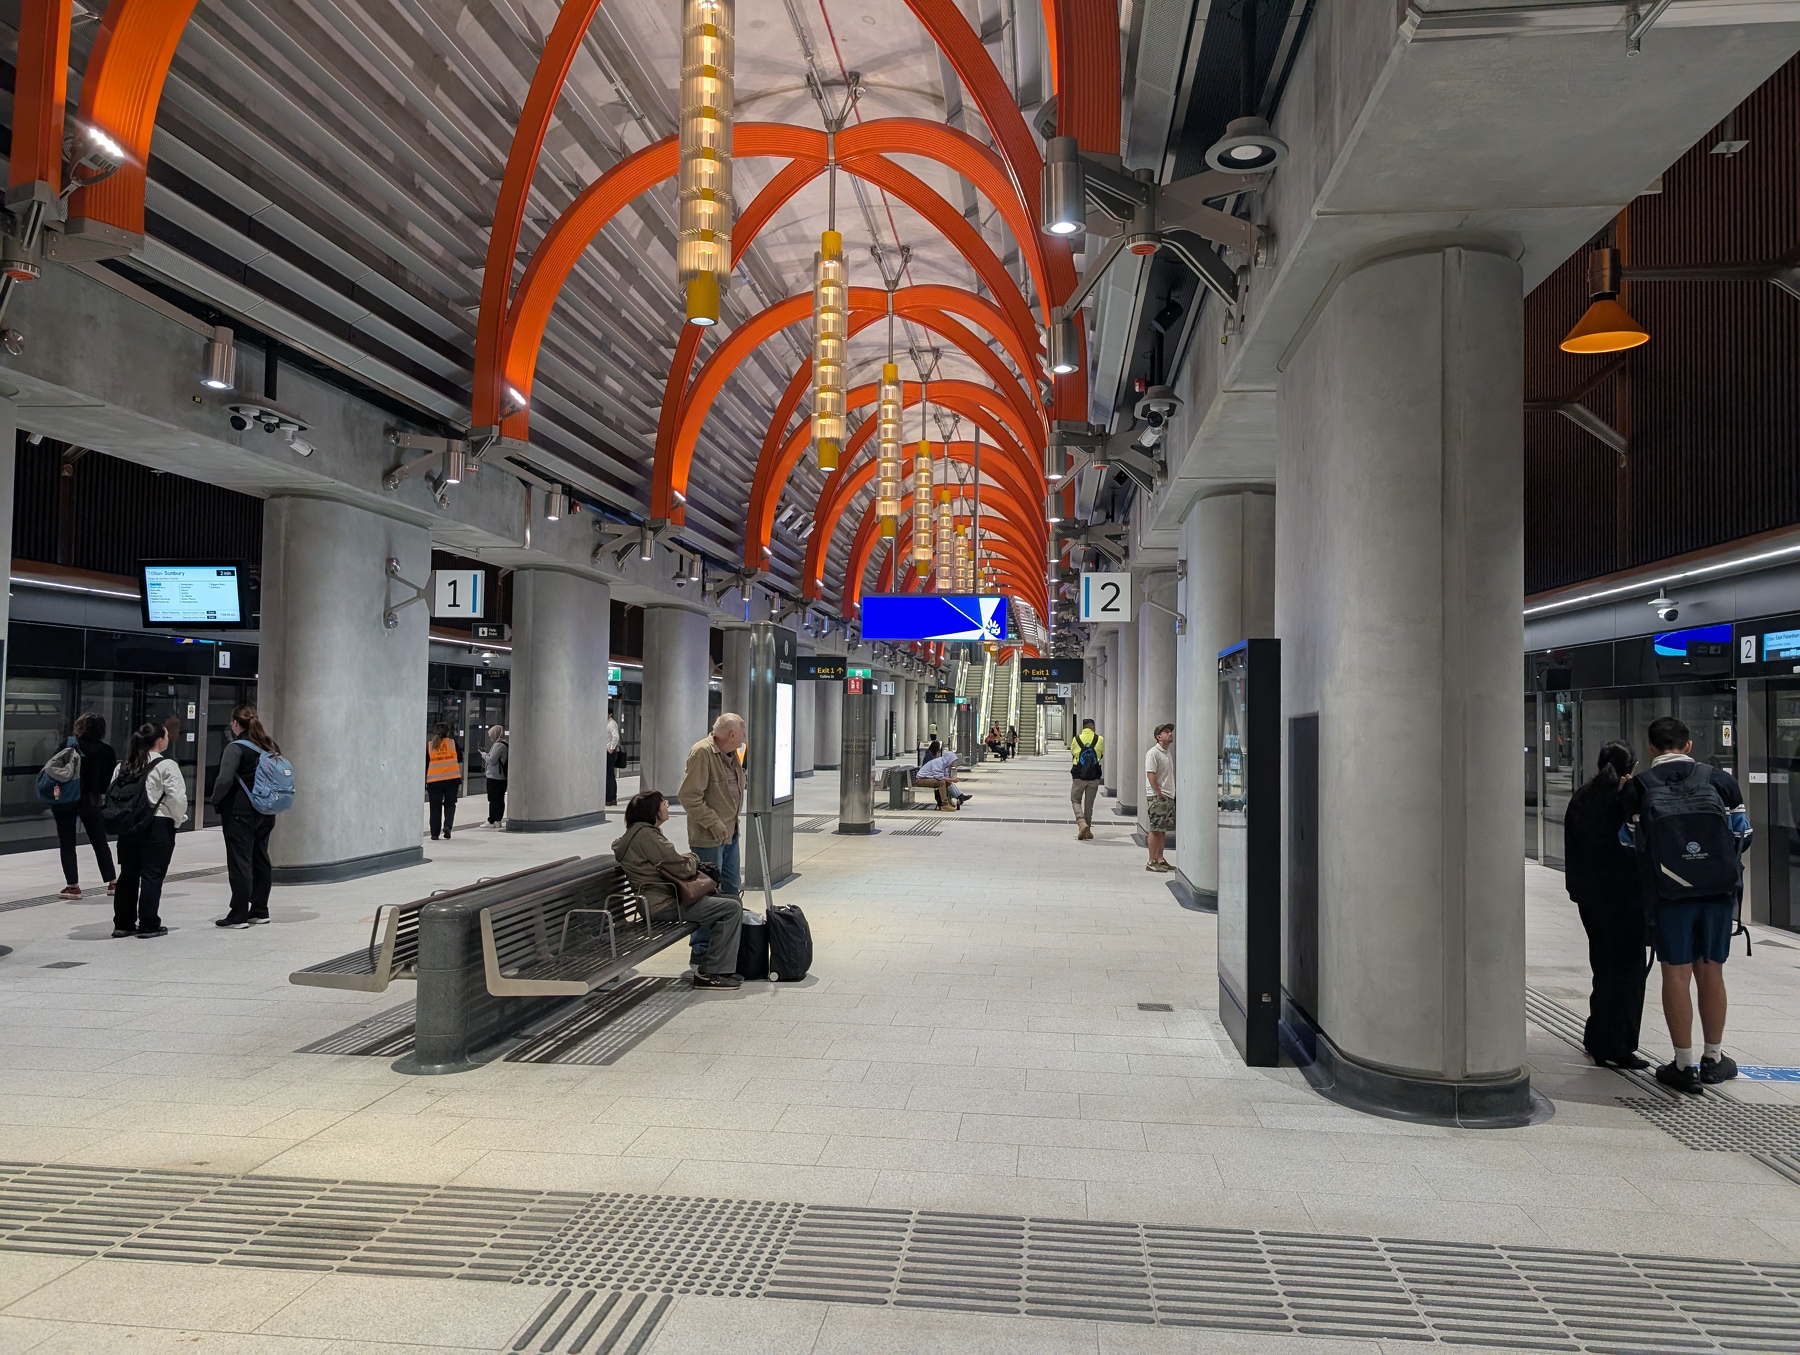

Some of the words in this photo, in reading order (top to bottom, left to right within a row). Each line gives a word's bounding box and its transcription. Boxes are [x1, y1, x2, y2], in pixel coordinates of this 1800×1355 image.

[447, 579, 461, 608] 1
[1100, 581, 1121, 612] 2
[1744, 639, 1752, 659] 2
[222, 653, 227, 666] 1
[1031, 668, 1045, 676] Exit
[1045, 668, 1050, 676] 1
[884, 684, 888, 693] 1
[1062, 686, 1069, 696] 2
